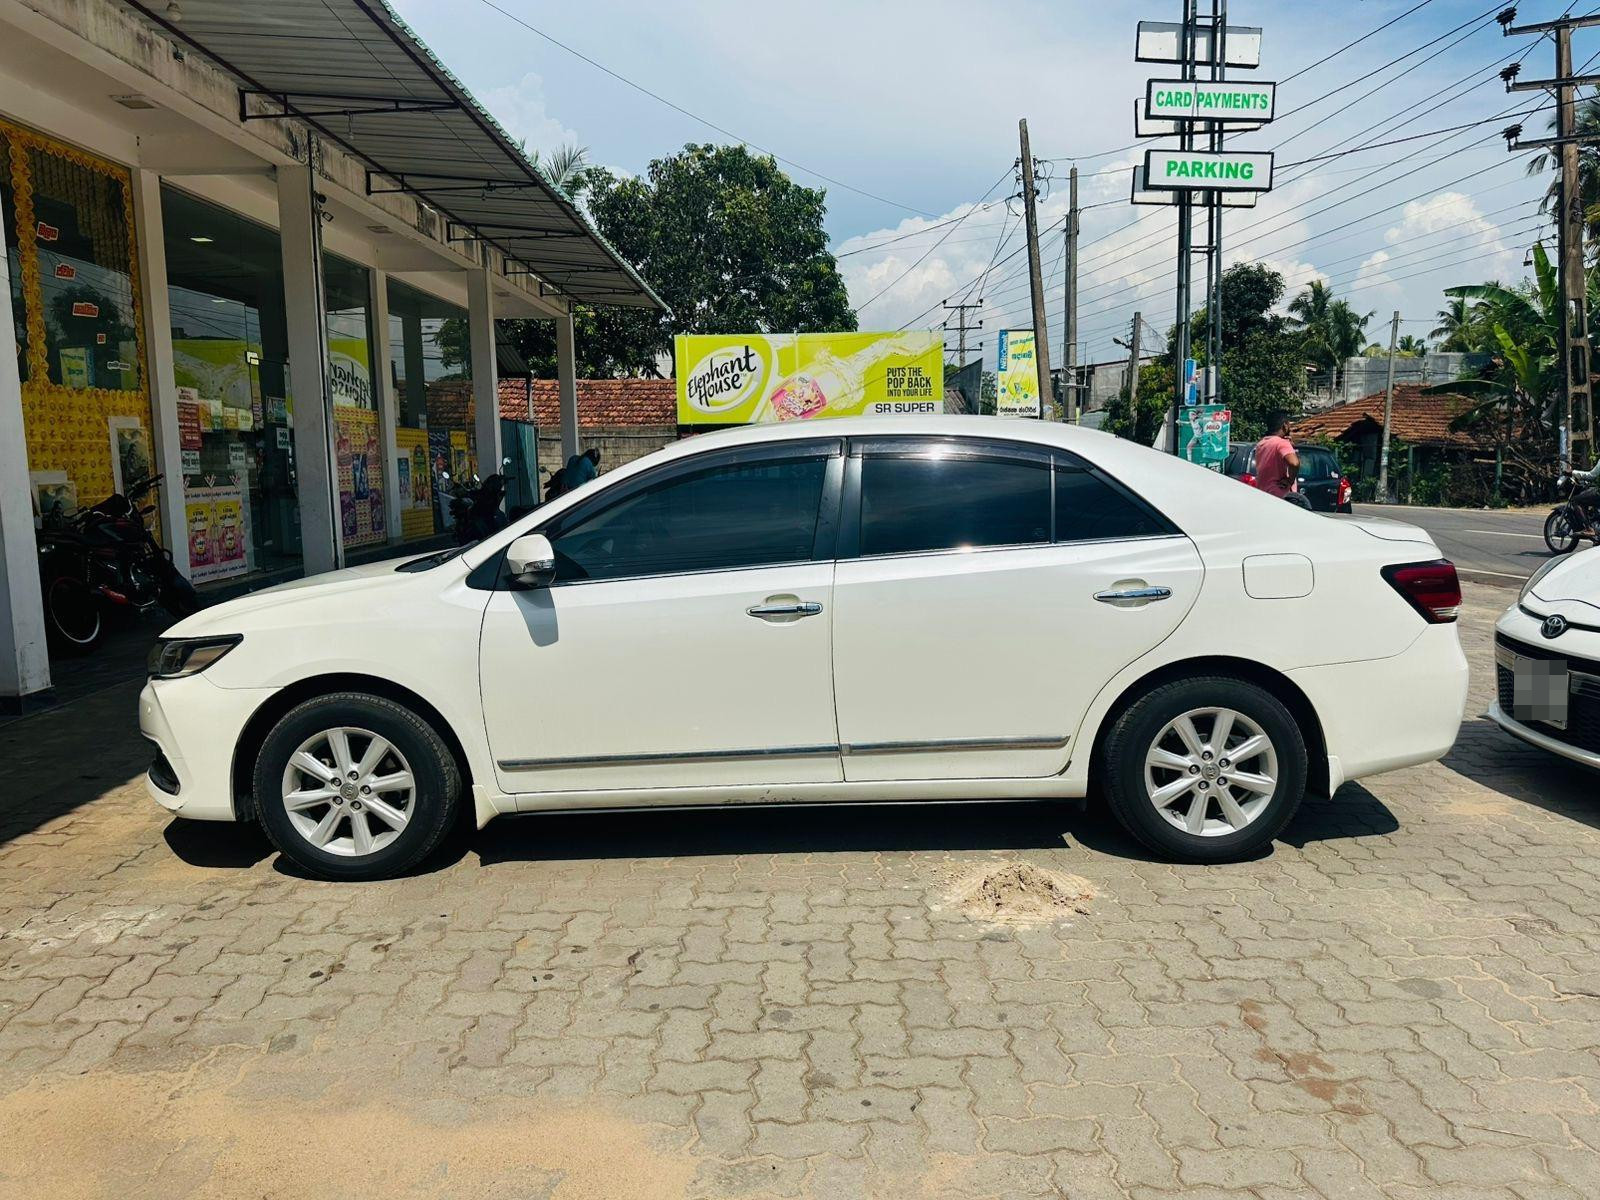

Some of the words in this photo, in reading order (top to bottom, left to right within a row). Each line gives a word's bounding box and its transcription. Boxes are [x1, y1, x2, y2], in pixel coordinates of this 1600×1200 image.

[1156, 91, 1192, 107] CARD
[1196, 92, 1268, 109] PAYMENTS
[1166, 160, 1253, 179] PARKING
[687, 345, 757, 398] Elephant
[887, 367, 906, 377] PUTS
[908, 367, 923, 377] THE
[698, 373, 742, 407] House
[887, 377, 905, 388] POP
[907, 377, 932, 388] BACK
[887, 389, 901, 397] INTO
[903, 389, 919, 397] YOUR
[920, 388, 933, 397] LIFE
[875, 403, 892, 414] SR
[894, 402, 935, 413] SUPER
